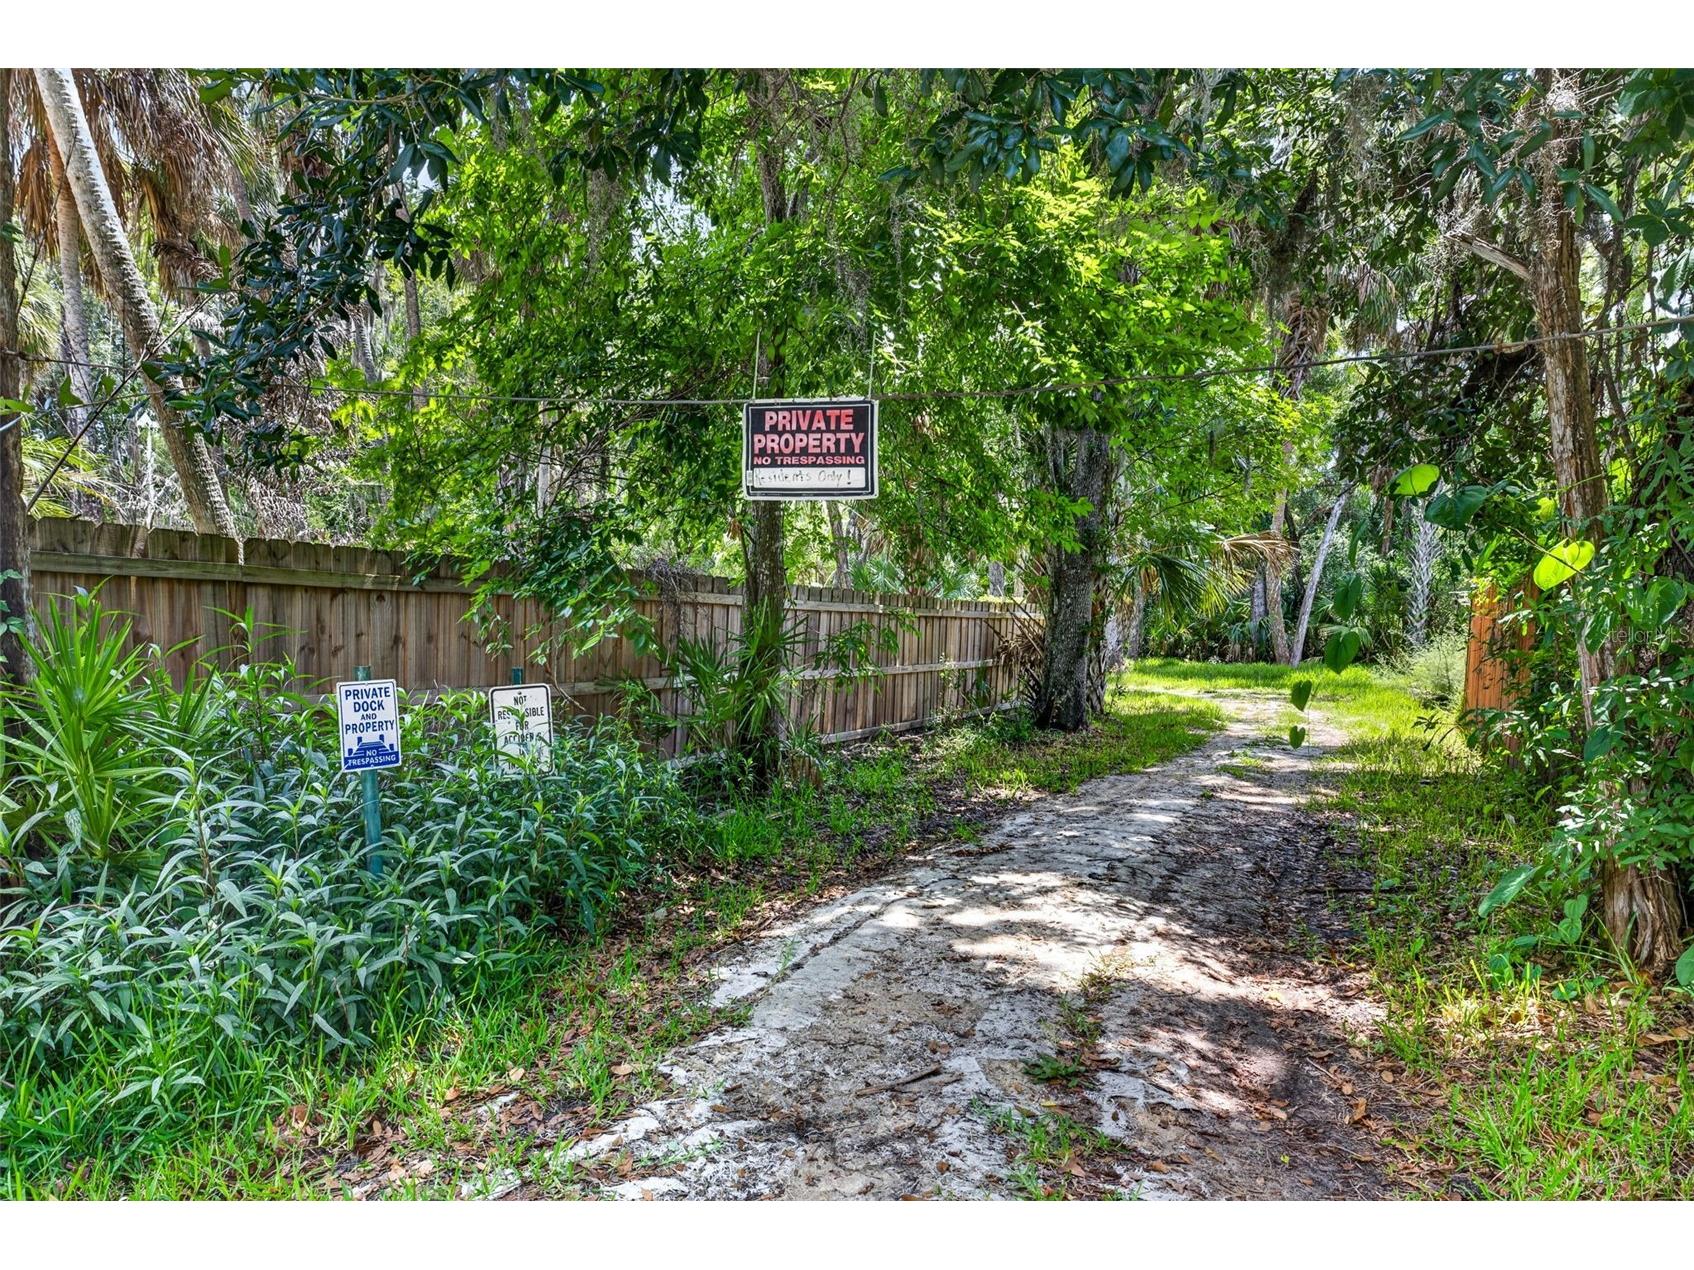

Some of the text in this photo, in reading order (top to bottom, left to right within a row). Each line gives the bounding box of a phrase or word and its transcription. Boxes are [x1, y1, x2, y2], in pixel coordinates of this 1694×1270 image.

[764, 409, 854, 431] PRIVATE
[753, 432, 865, 454] PROPERTY
[753, 456, 865, 465] NO TRESPASSING
[345, 687, 391, 700] PRIVATE
[353, 700, 385, 713] DOCK
[513, 695, 527, 706] NOT
[497, 706, 545, 720] RESSIBLE
[345, 720, 395, 735] PROPERTY
[366, 749, 377, 757] NO
[348, 754, 396, 767] TRESPASSING
